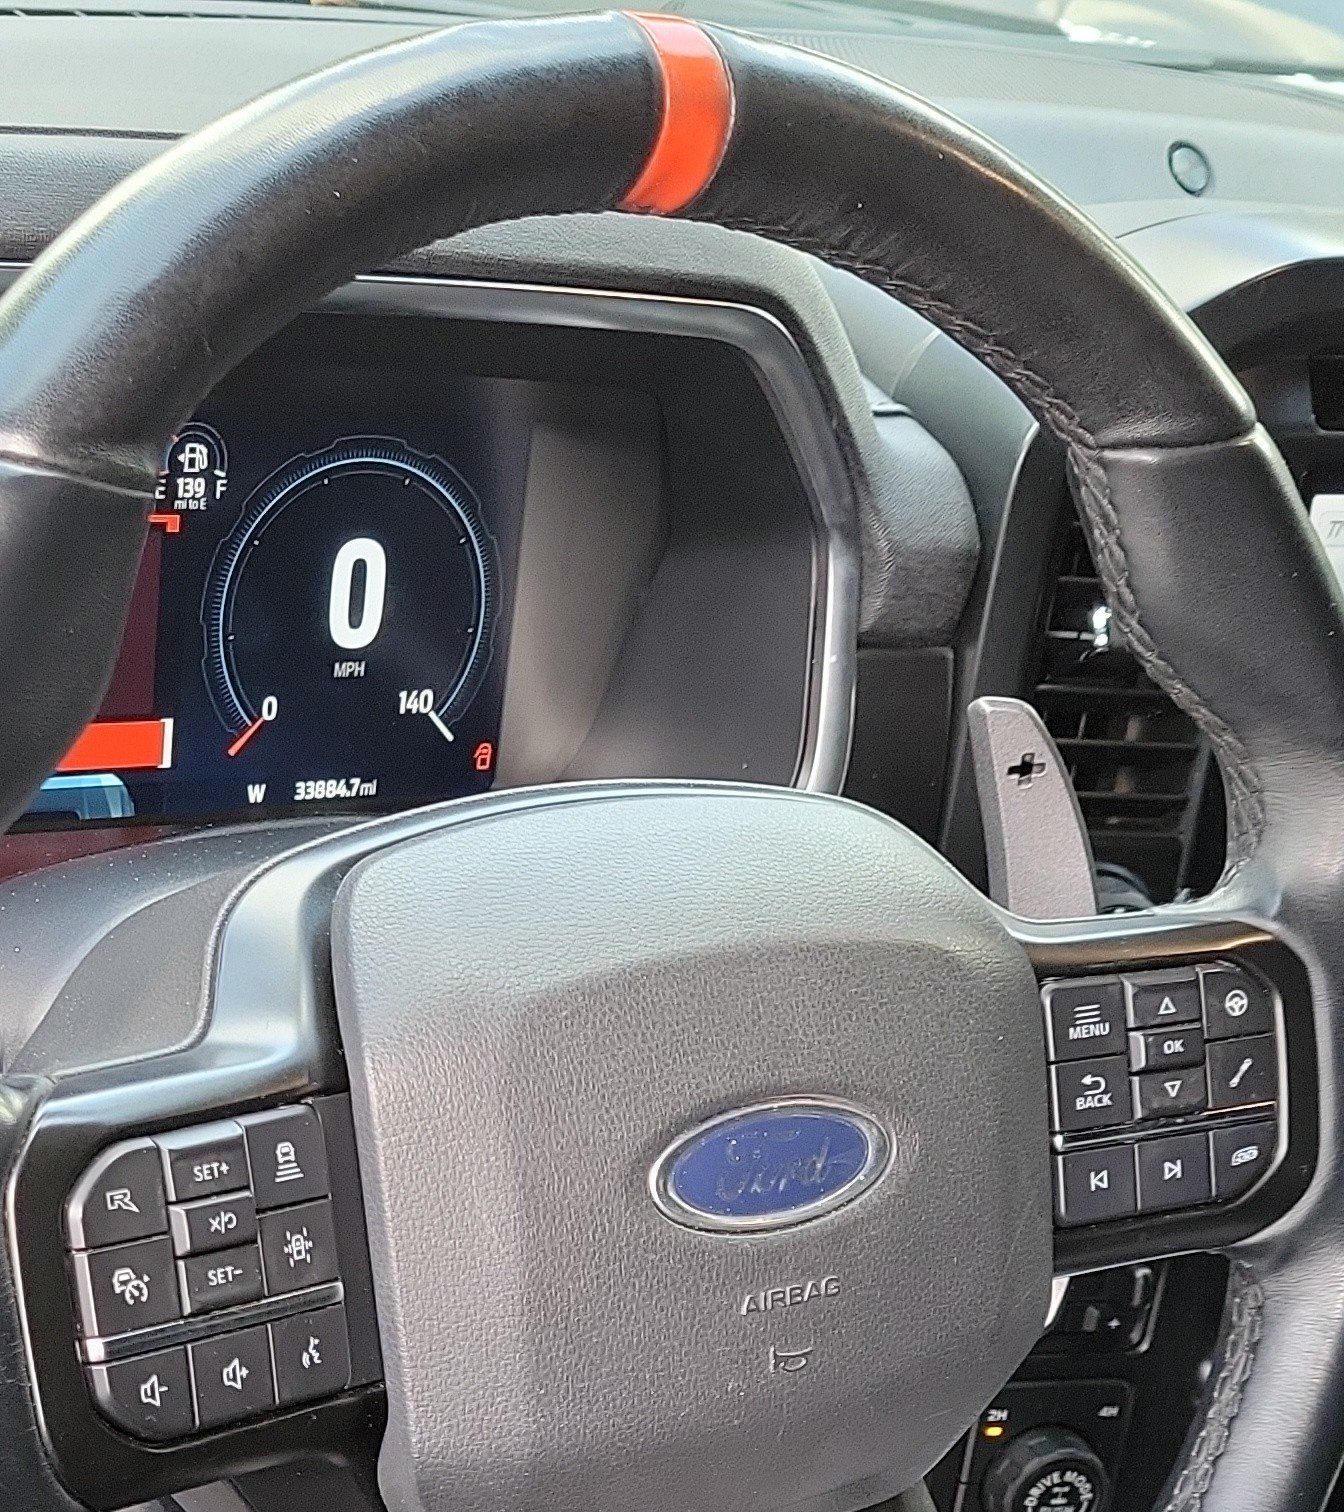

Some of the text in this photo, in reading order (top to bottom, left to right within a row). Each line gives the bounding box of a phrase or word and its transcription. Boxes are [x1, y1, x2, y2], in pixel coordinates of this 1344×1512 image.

[176, 477, 206, 499] 139
[216, 479, 228, 500] F
[328, 537, 387, 650] 0
[333, 660, 366, 679] MPH
[261, 688, 434, 722] 0 140
[247, 783, 267, 804] W
[1068, 1022, 1110, 1041] MENU
[1163, 1039, 1186, 1055] OK
[1075, 1092, 1113, 1111] BACK
[192, 1162, 232, 1183] SET+
[740, 1275, 841, 1317] AIRBAG
[1022, 1470, 1094, 1508] DRIVE MODE
